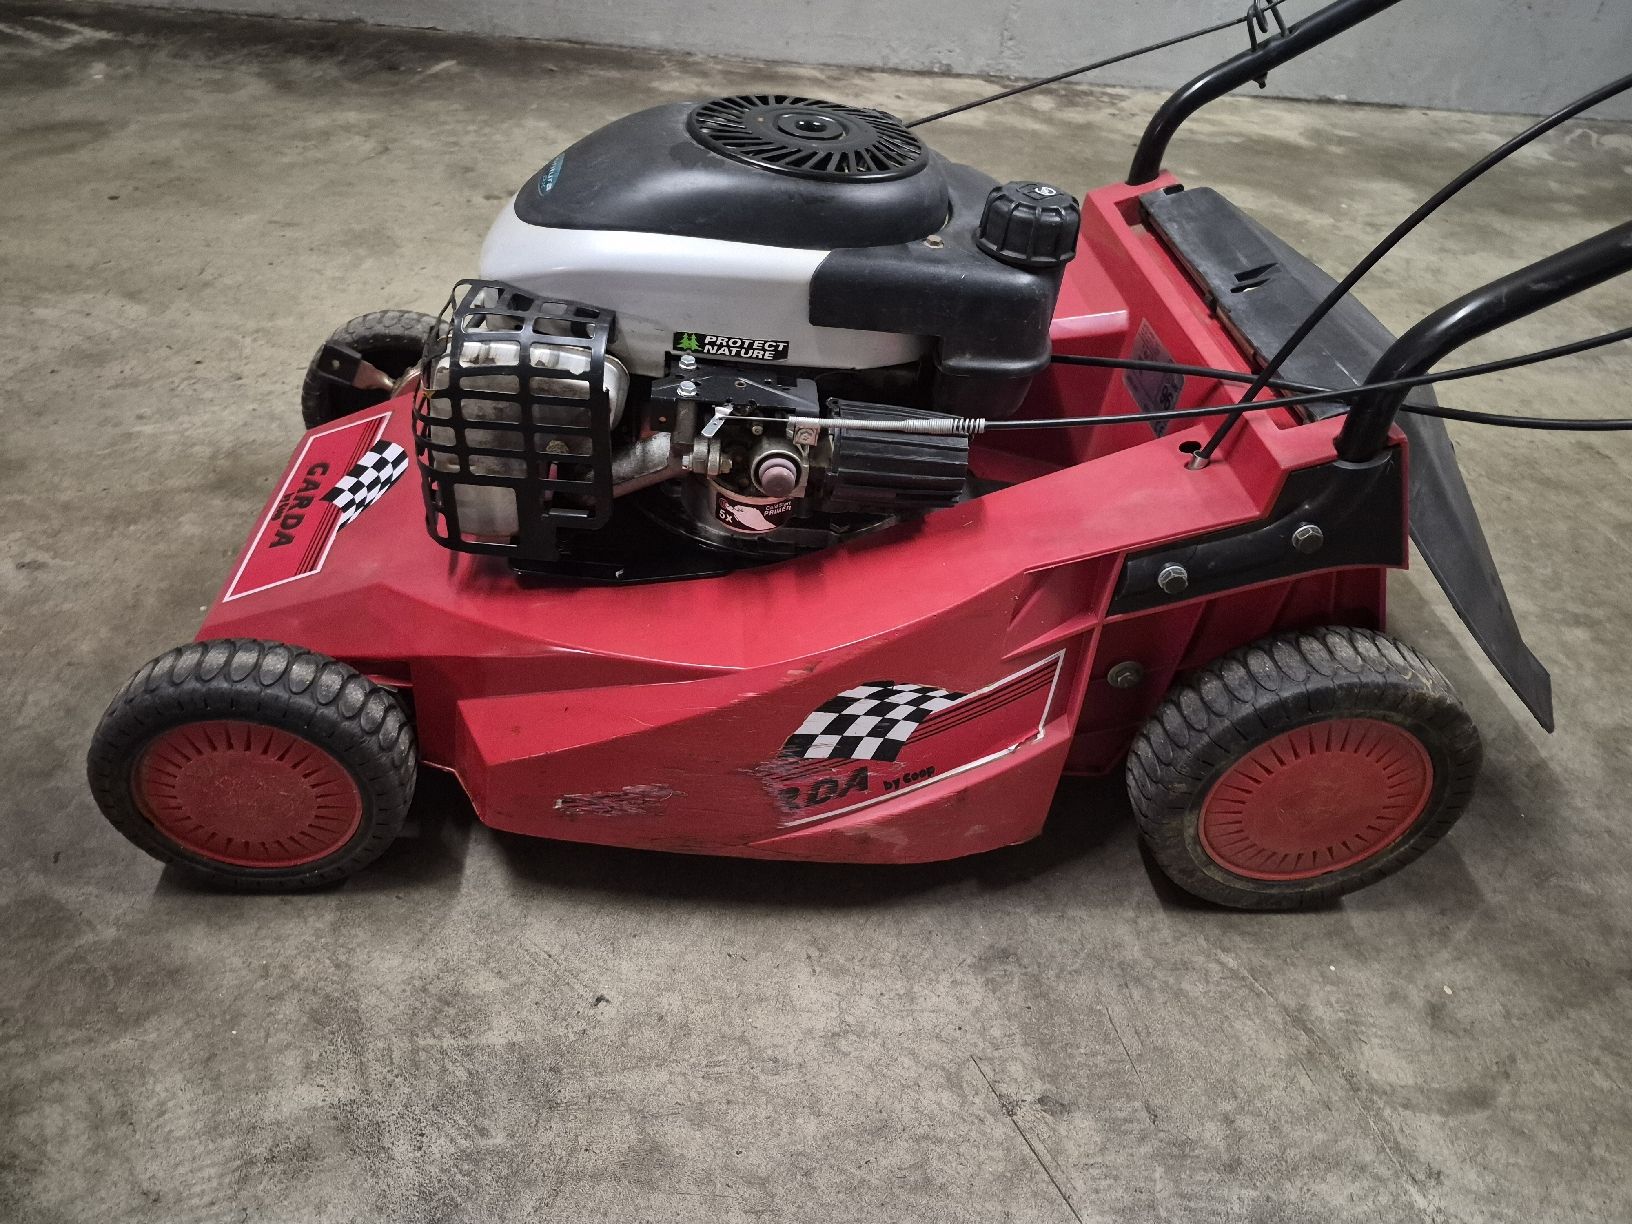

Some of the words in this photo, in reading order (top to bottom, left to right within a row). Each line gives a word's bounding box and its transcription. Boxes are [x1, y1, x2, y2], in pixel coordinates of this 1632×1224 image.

[704, 335, 788, 351] PROTECT
[703, 345, 776, 360] NATURE
[268, 462, 330, 548] GARDA
[764, 505, 792, 516] PRIMER
[719, 509, 733, 523] 5x
[883, 778, 900, 791] by
[902, 766, 936, 784] Coop
